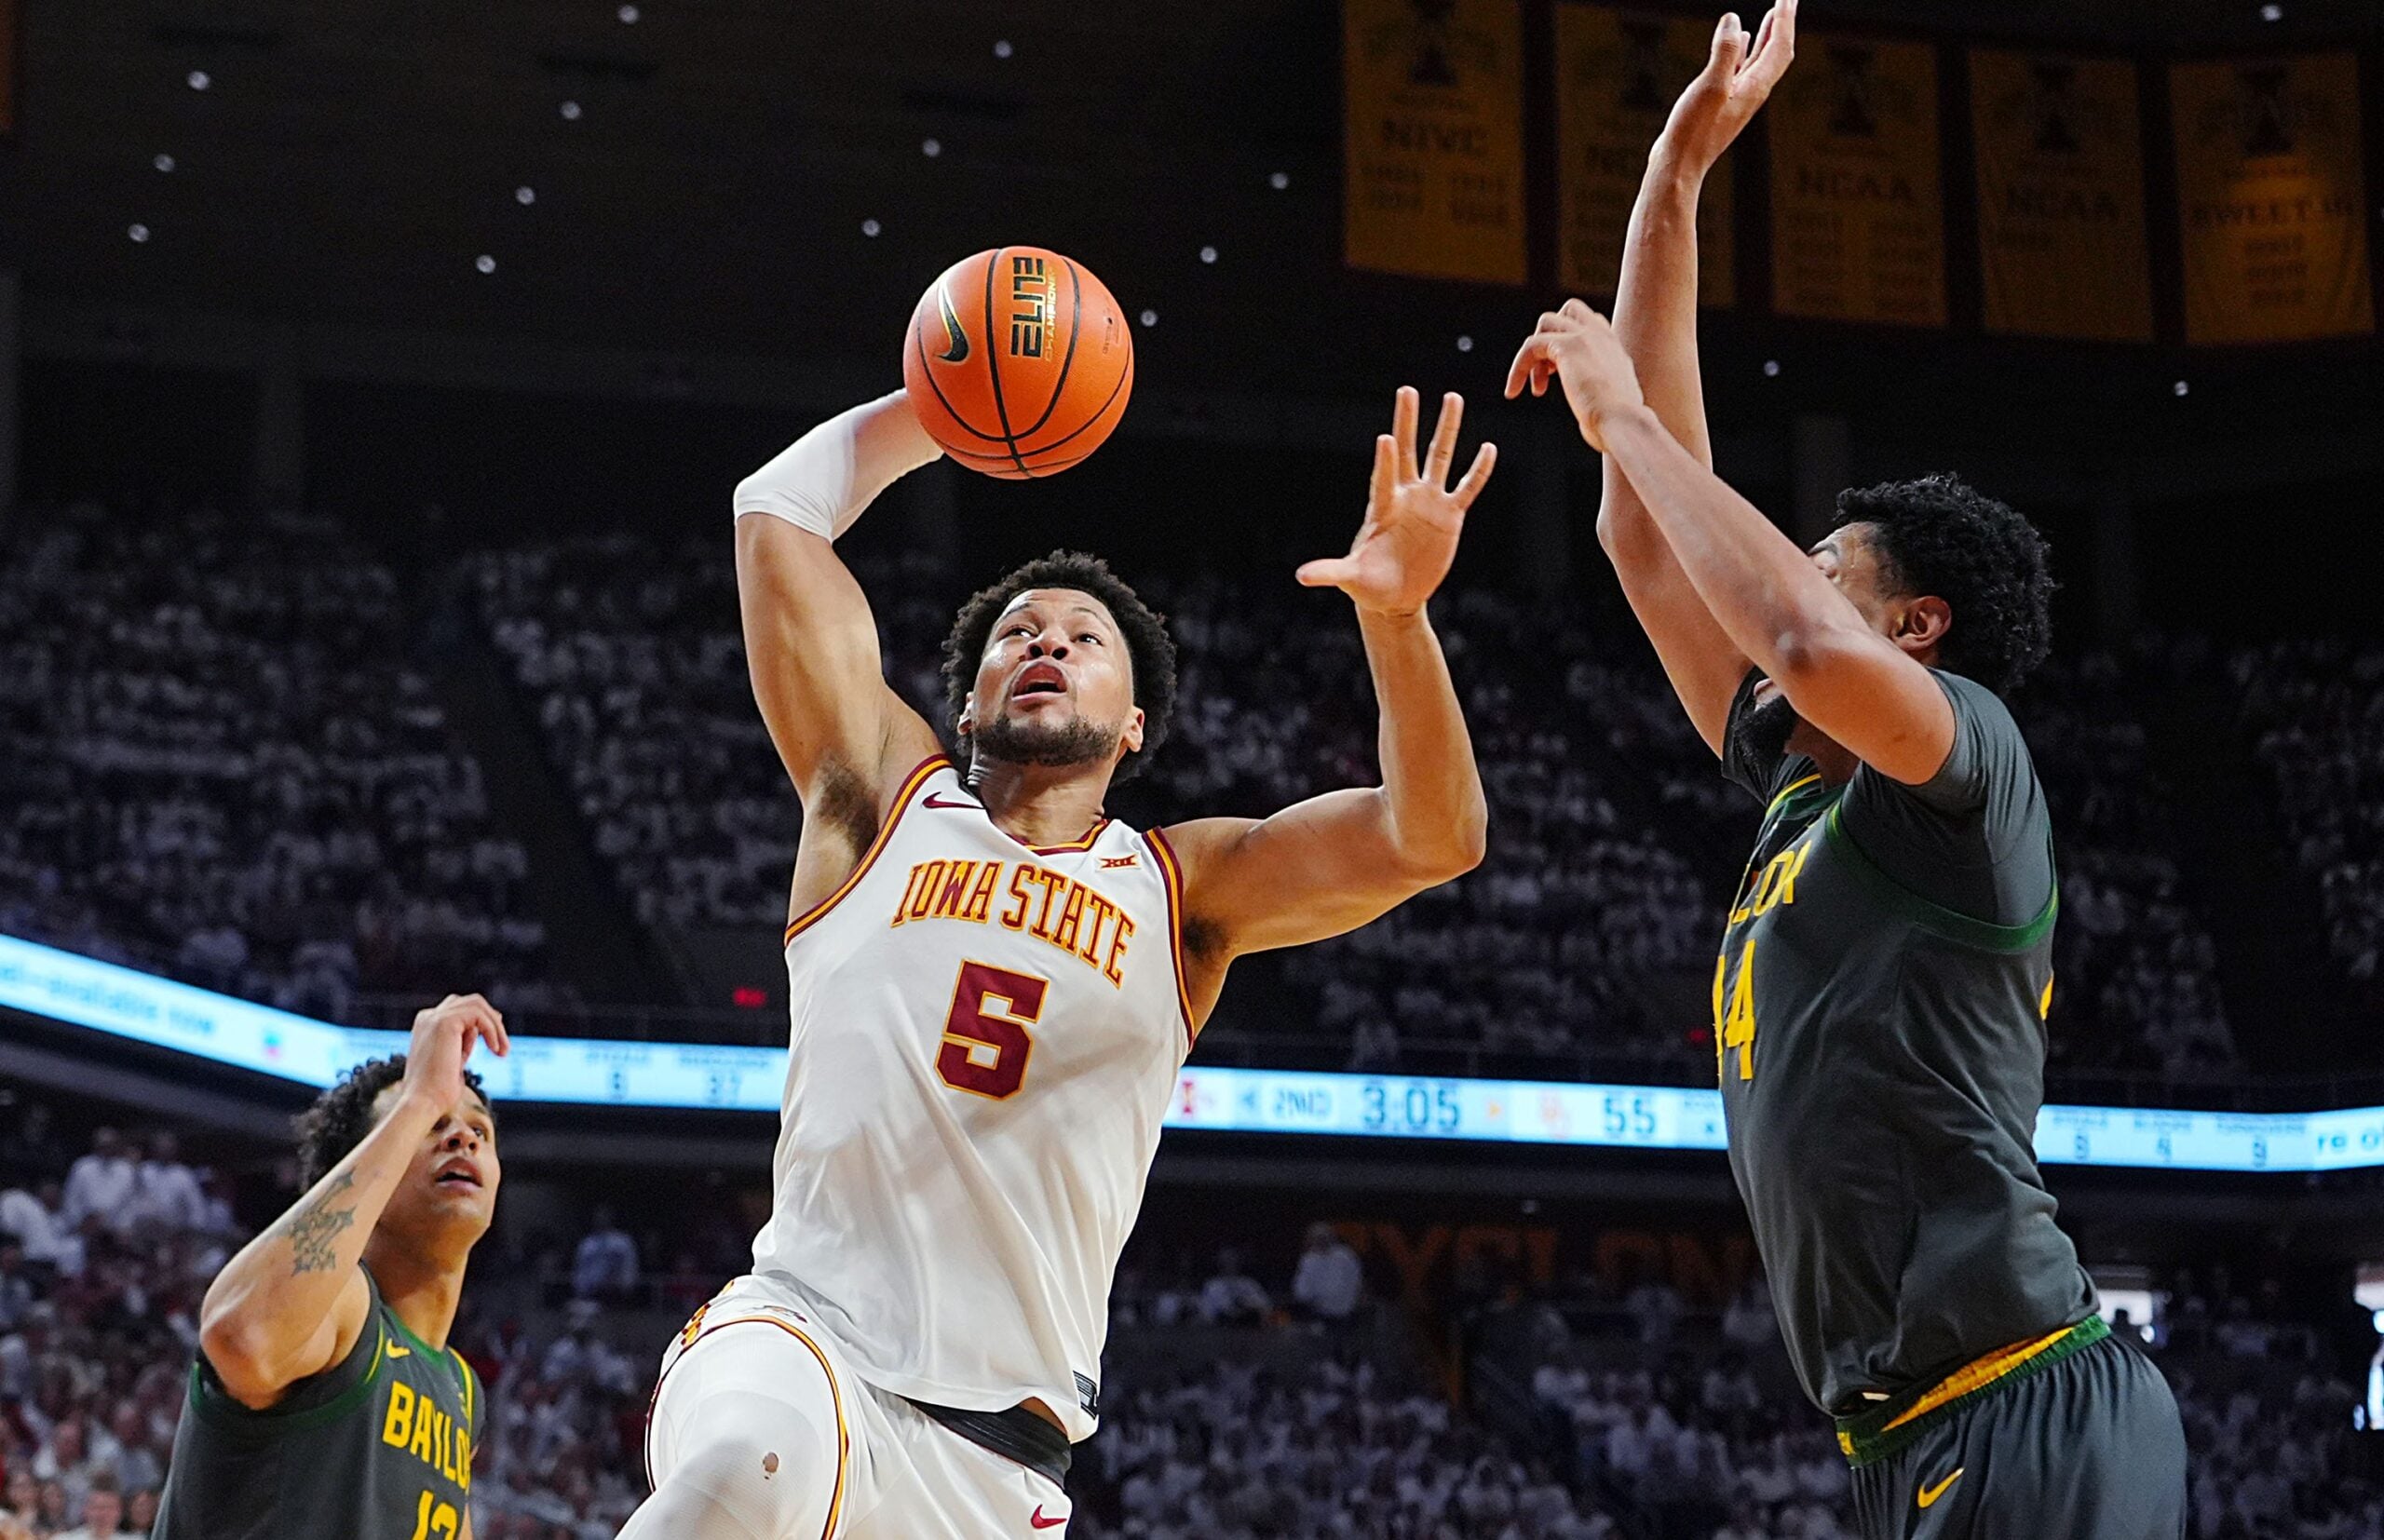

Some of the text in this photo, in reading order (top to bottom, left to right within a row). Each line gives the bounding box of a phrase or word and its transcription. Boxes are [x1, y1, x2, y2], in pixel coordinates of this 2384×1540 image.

[1011, 256, 1046, 358] ELITE
[890, 858, 1137, 990] IOWA STATE
[934, 958, 1050, 1101] 5
[1272, 1087, 1333, 1118] 2ND
[1604, 1093, 1657, 1137] 55
[382, 1380, 471, 1495] BAYLO
